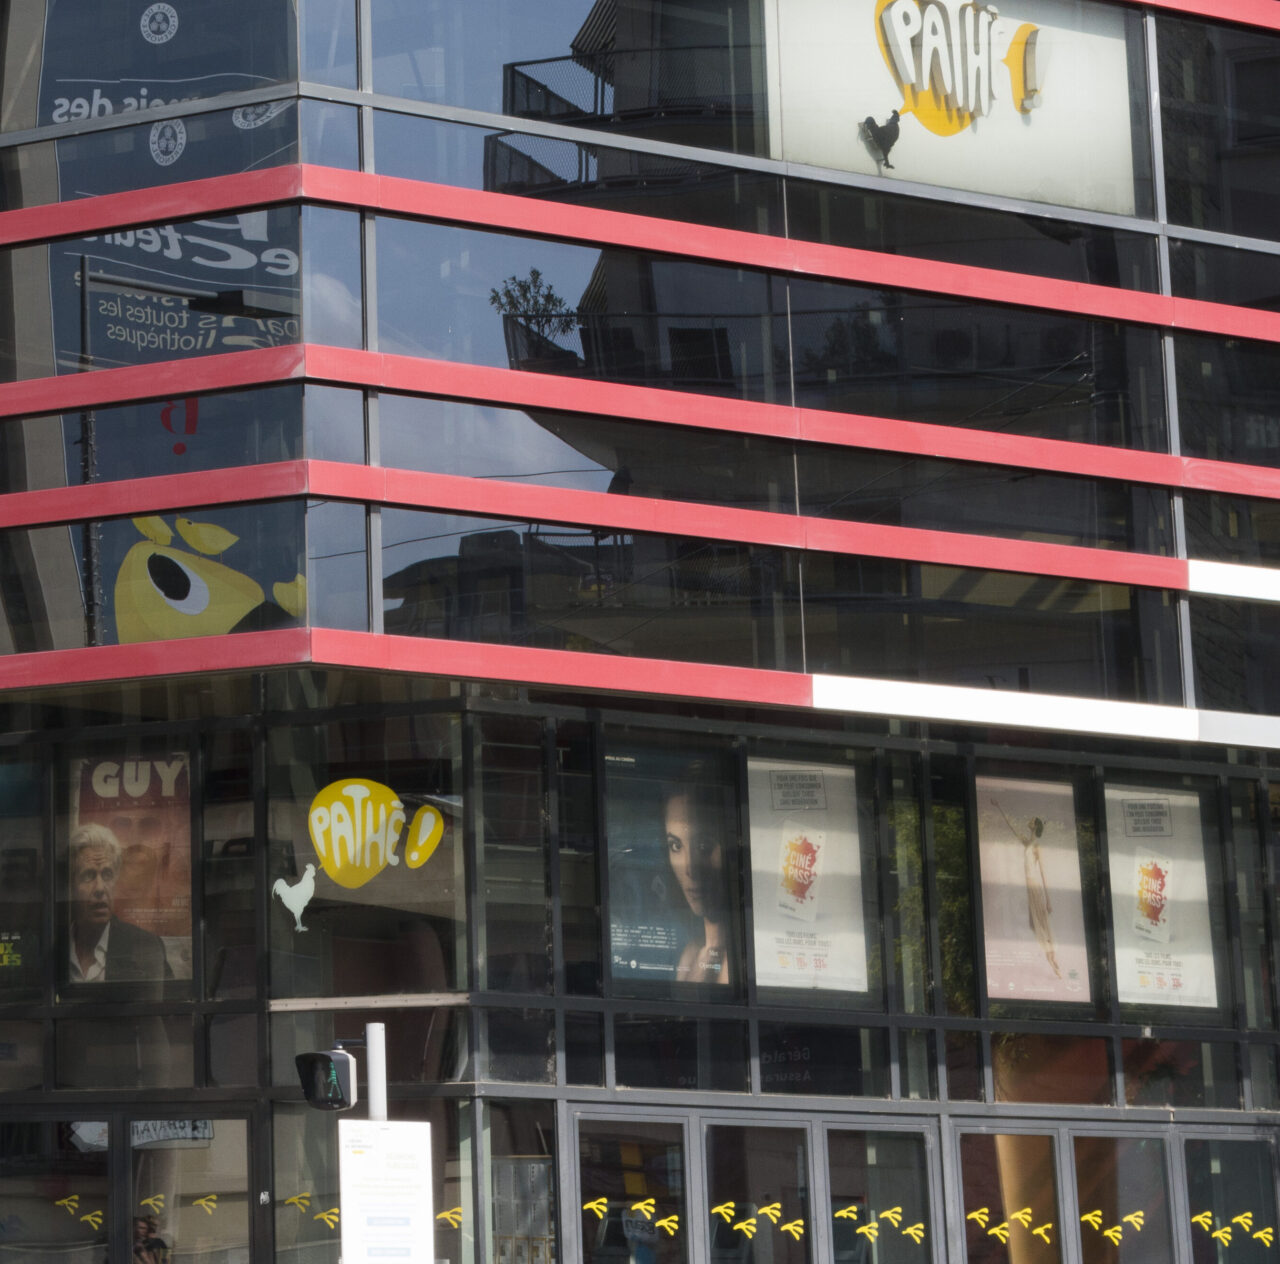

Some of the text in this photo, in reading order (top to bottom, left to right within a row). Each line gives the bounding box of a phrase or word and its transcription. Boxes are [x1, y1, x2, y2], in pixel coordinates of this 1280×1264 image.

[92, 761, 184, 798] GUY
[788, 865, 810, 884] PASS
[1142, 891, 1161, 908] PASS
